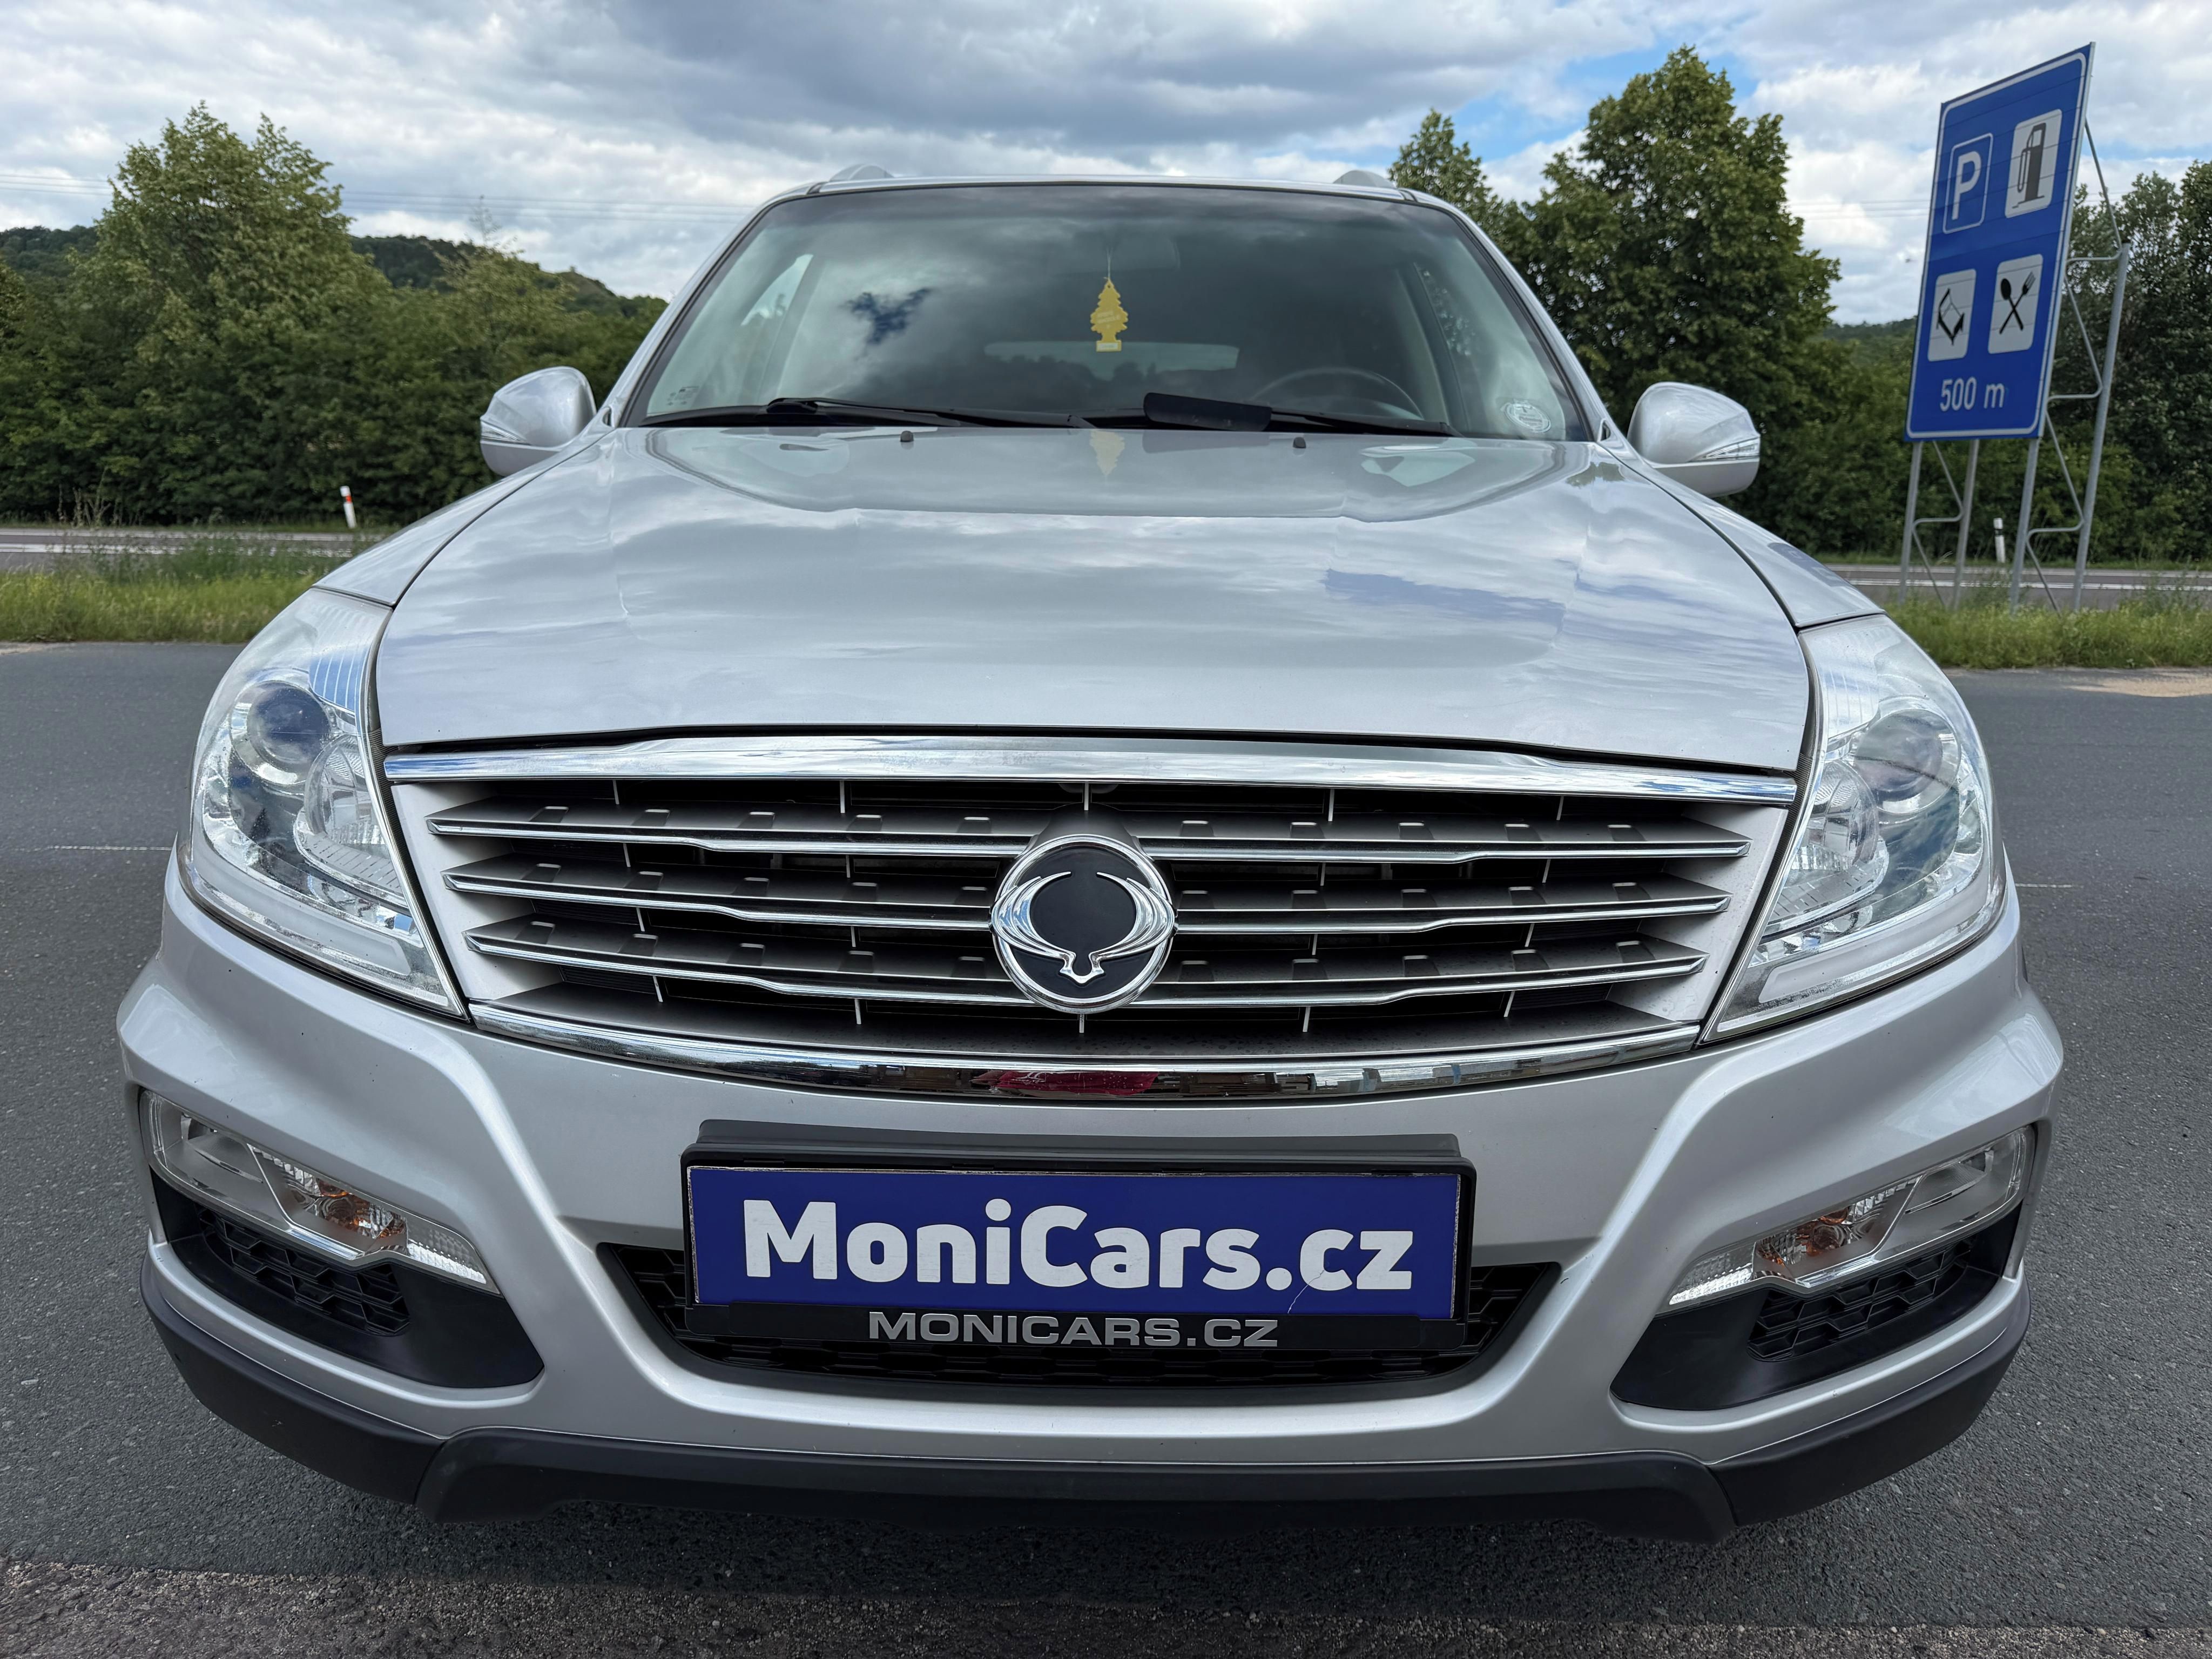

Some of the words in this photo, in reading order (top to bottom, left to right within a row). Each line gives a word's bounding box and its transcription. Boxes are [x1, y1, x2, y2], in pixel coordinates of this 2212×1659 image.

[1952, 151, 1981, 220] P
[1940, 376, 1977, 412] 500
[1984, 383, 2005, 409] m
[743, 1198, 1413, 1291] MoniCars.cz
[868, 1311, 1278, 1347] MONICARS.CZ
